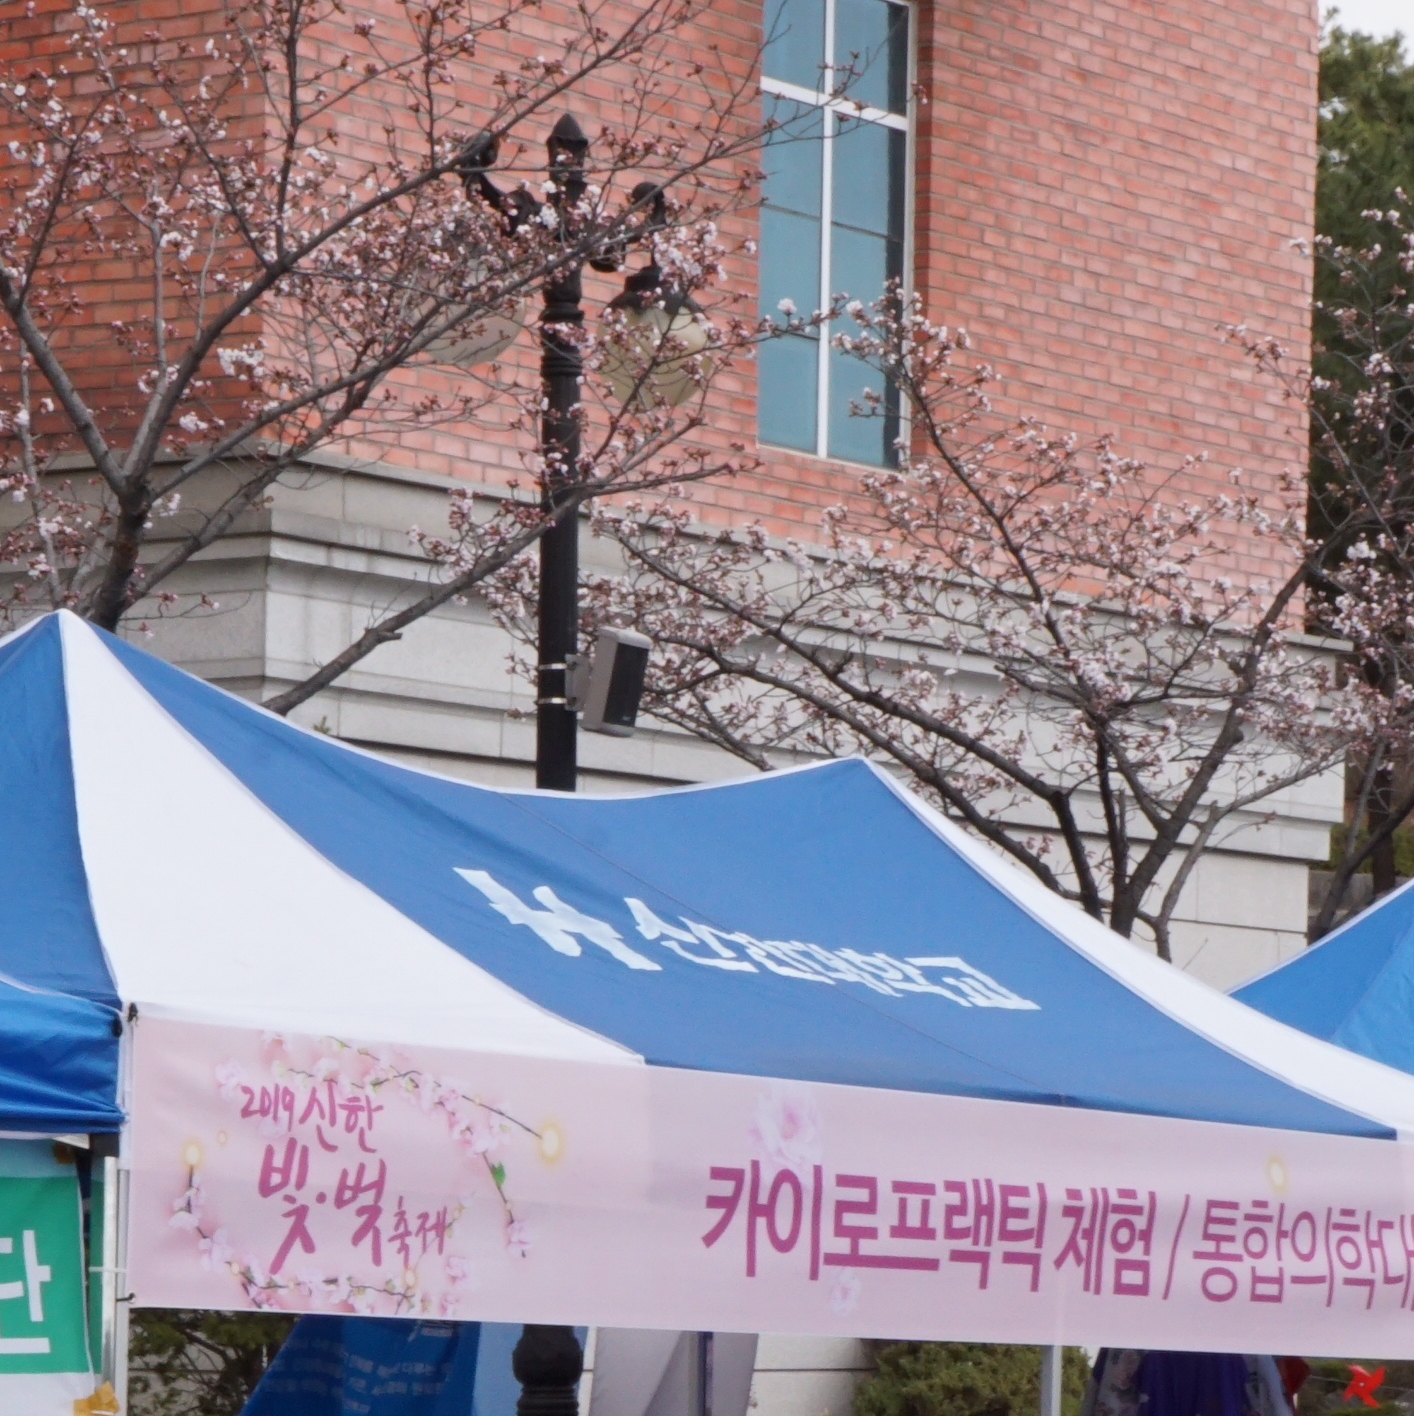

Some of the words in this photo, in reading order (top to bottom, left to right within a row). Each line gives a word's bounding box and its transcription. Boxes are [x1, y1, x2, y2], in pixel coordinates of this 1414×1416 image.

[298, 1079, 384, 1153] 신한
[700, 1158, 1049, 1295] 카이로프랙틱
[1052, 1186, 1158, 1299] 체험
